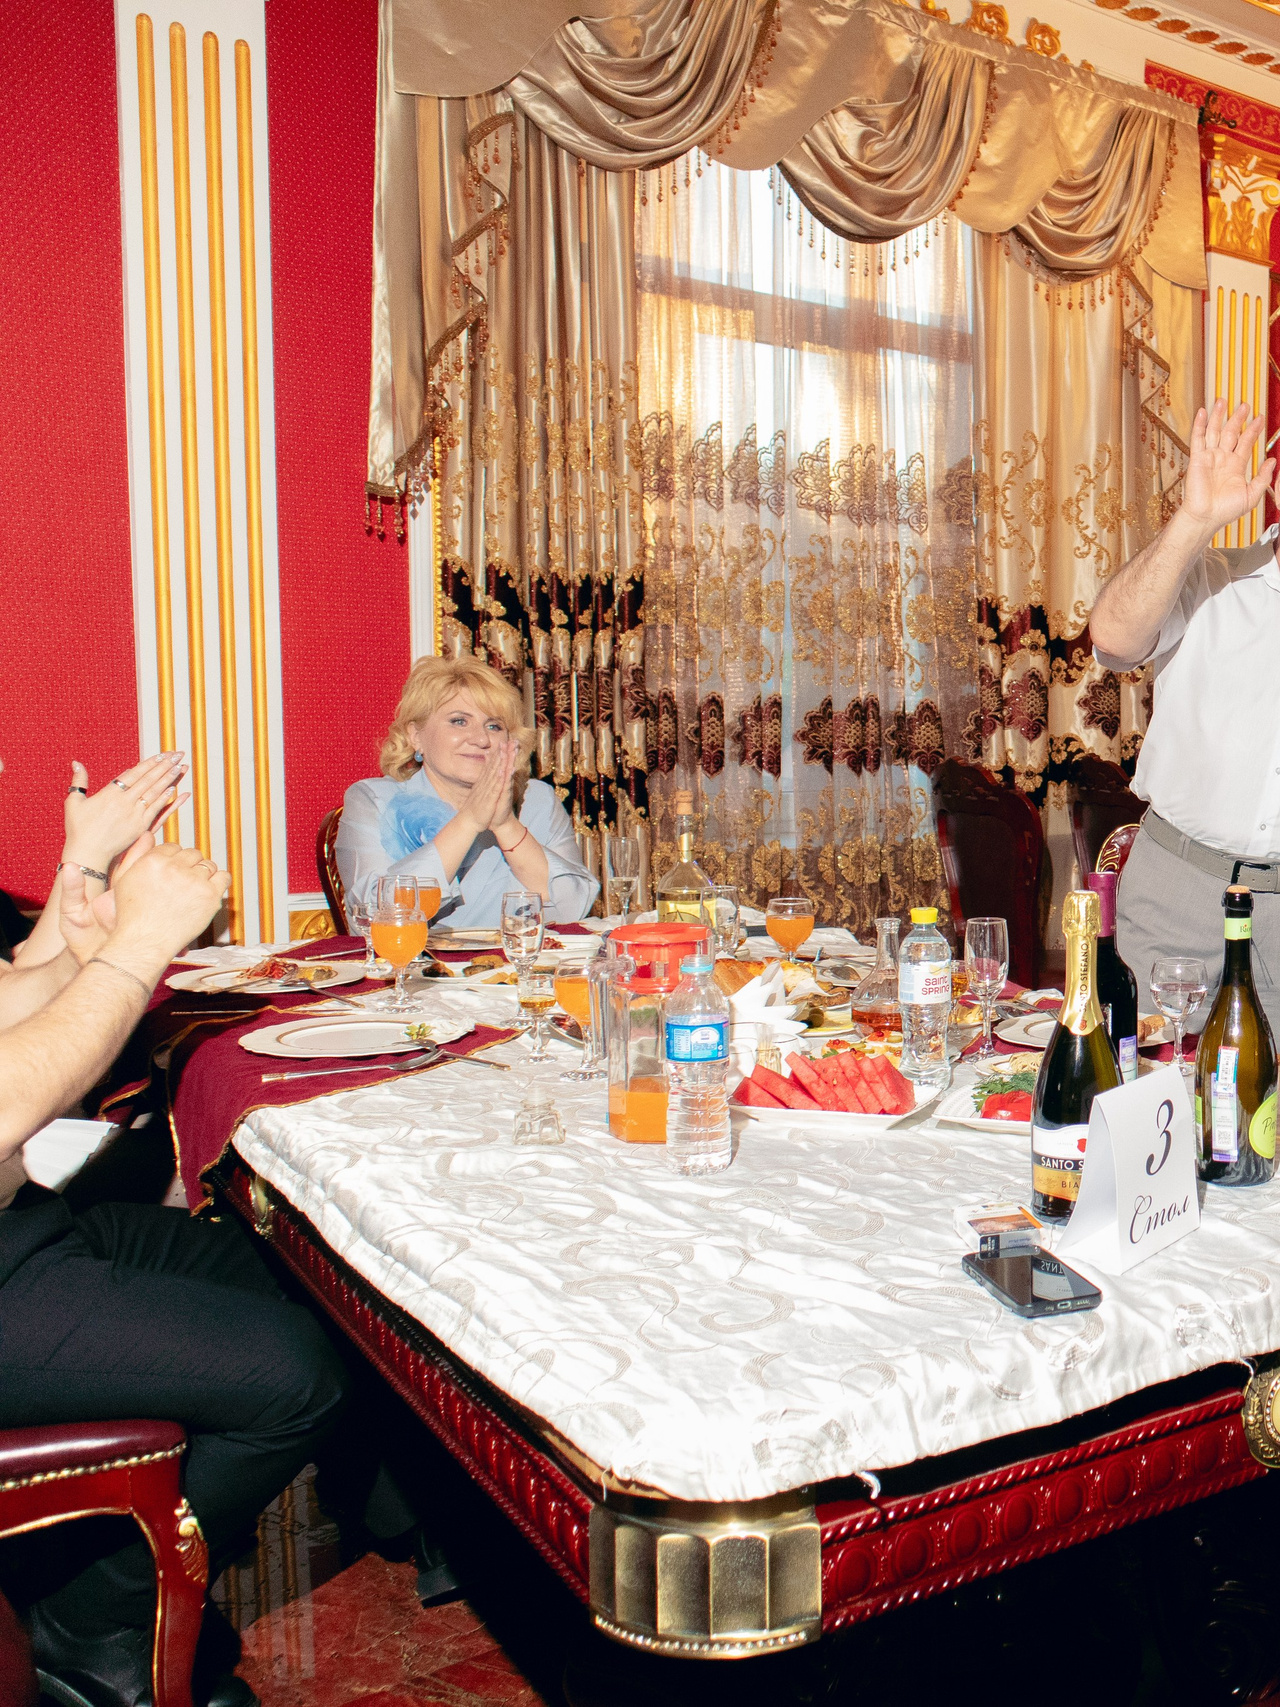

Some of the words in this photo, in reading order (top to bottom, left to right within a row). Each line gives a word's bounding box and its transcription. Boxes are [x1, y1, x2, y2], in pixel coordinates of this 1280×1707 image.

[1080, 943, 1089, 981] STEFANO
[1145, 1098, 1174, 1176] 3
[1040, 1156, 1075, 1171] SANTO
[1129, 1194, 1190, 1245] Стол
